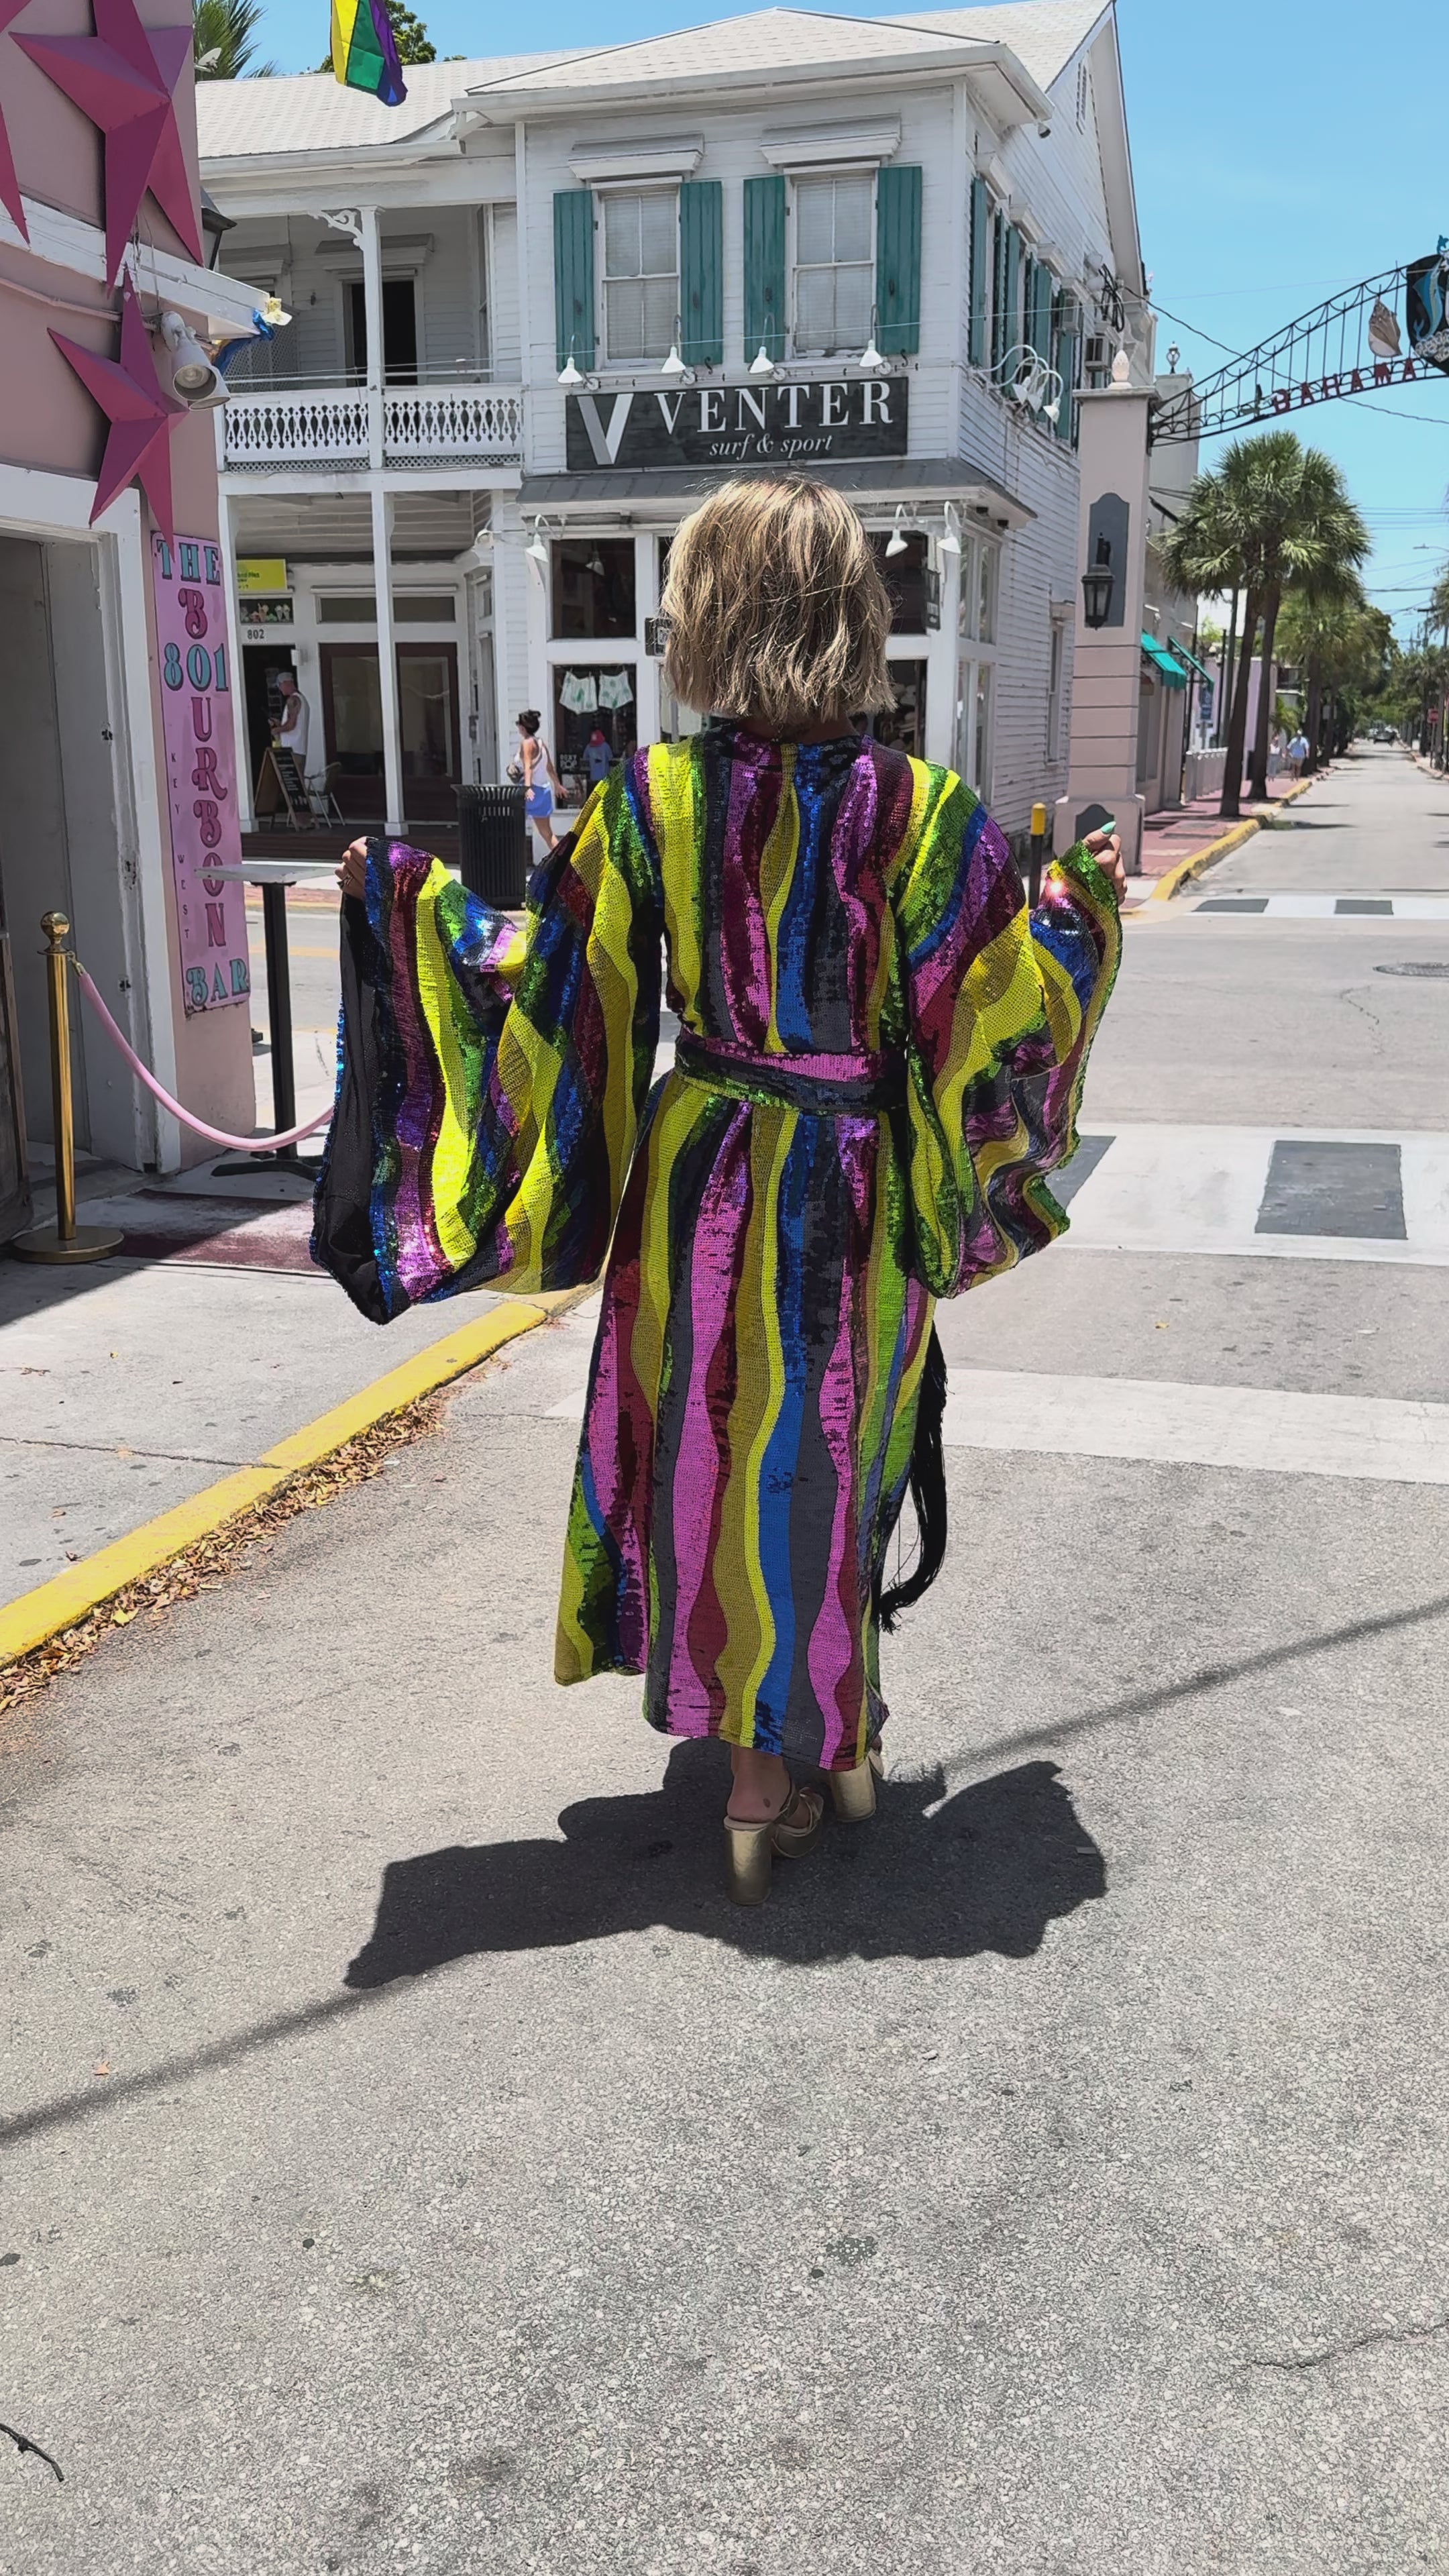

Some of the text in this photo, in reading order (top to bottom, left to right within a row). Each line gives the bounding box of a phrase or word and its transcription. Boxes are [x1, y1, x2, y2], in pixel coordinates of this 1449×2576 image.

[653, 381, 894, 435] VENTER
[1272, 357, 1417, 415] BAHAMA
[709, 433, 833, 460] surf & sport
[156, 539, 221, 586] THE
[247, 629, 265, 640] 802
[164, 642, 229, 692] 801
[170, 752, 191, 939] KEY WEST
[185, 957, 251, 1007] BAR
